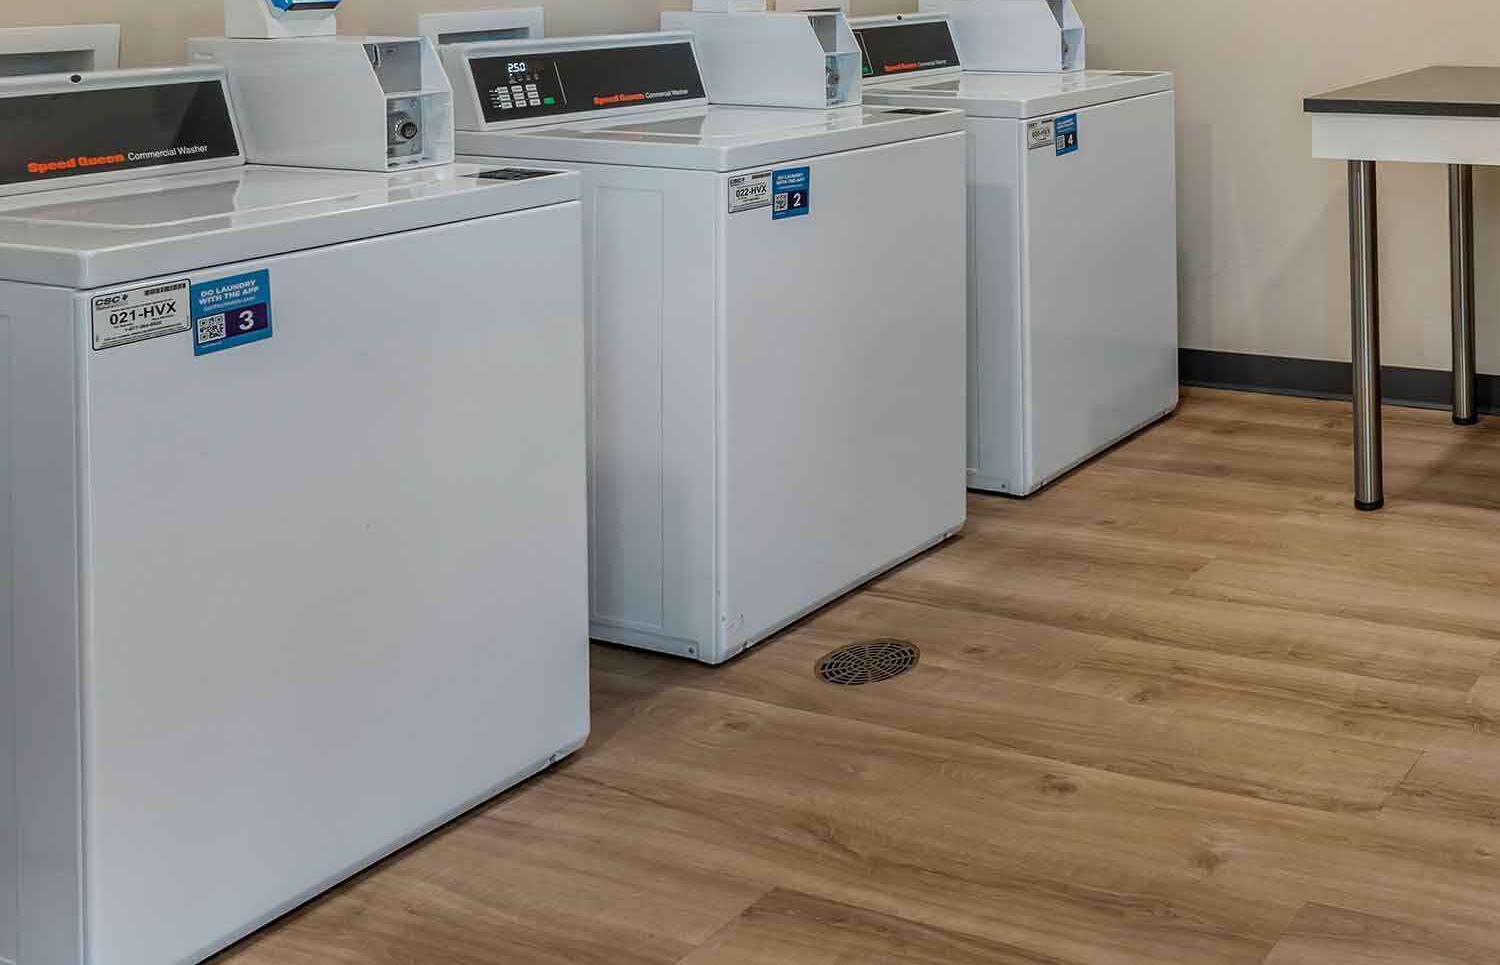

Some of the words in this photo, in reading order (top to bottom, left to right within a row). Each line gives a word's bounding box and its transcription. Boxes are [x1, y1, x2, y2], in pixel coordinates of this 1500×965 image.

[1068, 134, 1074, 145] 4
[27, 157, 77, 173] Speed
[78, 153, 125, 166] Queen
[128, 148, 177, 163] Commercial
[177, 144, 208, 156] Washer
[735, 183, 767, 198] 022-HVX
[793, 193, 801, 207] 2
[198, 295, 223, 305] WITH
[223, 291, 241, 300] THE
[242, 286, 260, 295] APP
[200, 289, 214, 298] DO
[215, 279, 257, 294] LAUNDRY
[95, 296, 121, 307] CSC
[110, 301, 177, 325] 021-HVX
[239, 310, 255, 331] 3
